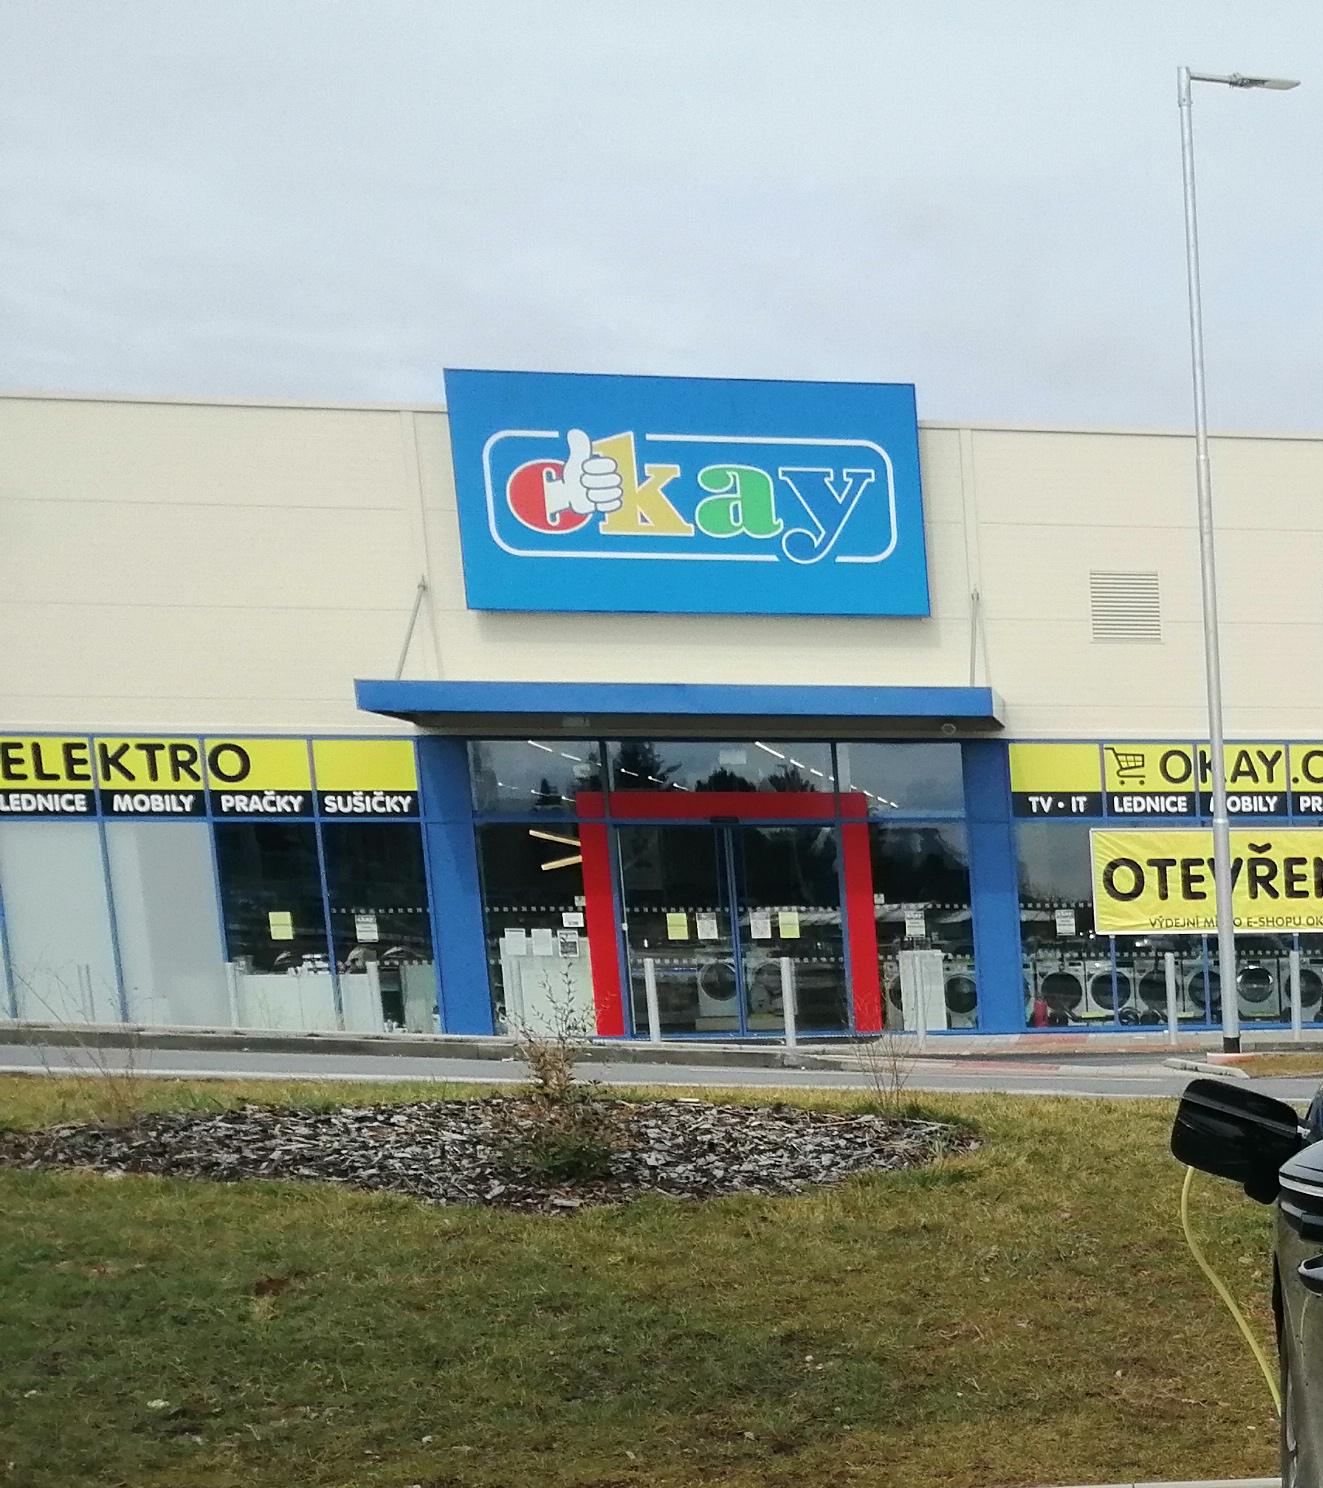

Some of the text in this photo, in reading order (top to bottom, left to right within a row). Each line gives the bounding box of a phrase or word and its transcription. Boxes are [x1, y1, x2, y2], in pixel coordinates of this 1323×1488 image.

[1, 741, 251, 783] ELEKTRO
[0, 790, 412, 813] LEDNICE MOBILY PRAČKY SUŠIČKY
[1028, 796, 1053, 813] TV
[1070, 796, 1087, 813] IT
[1113, 795, 1188, 813] LEDNICE
[1149, 914, 1199, 929] VÝDEJNÍ
[1247, 915, 1300, 928] E-SHOPU
